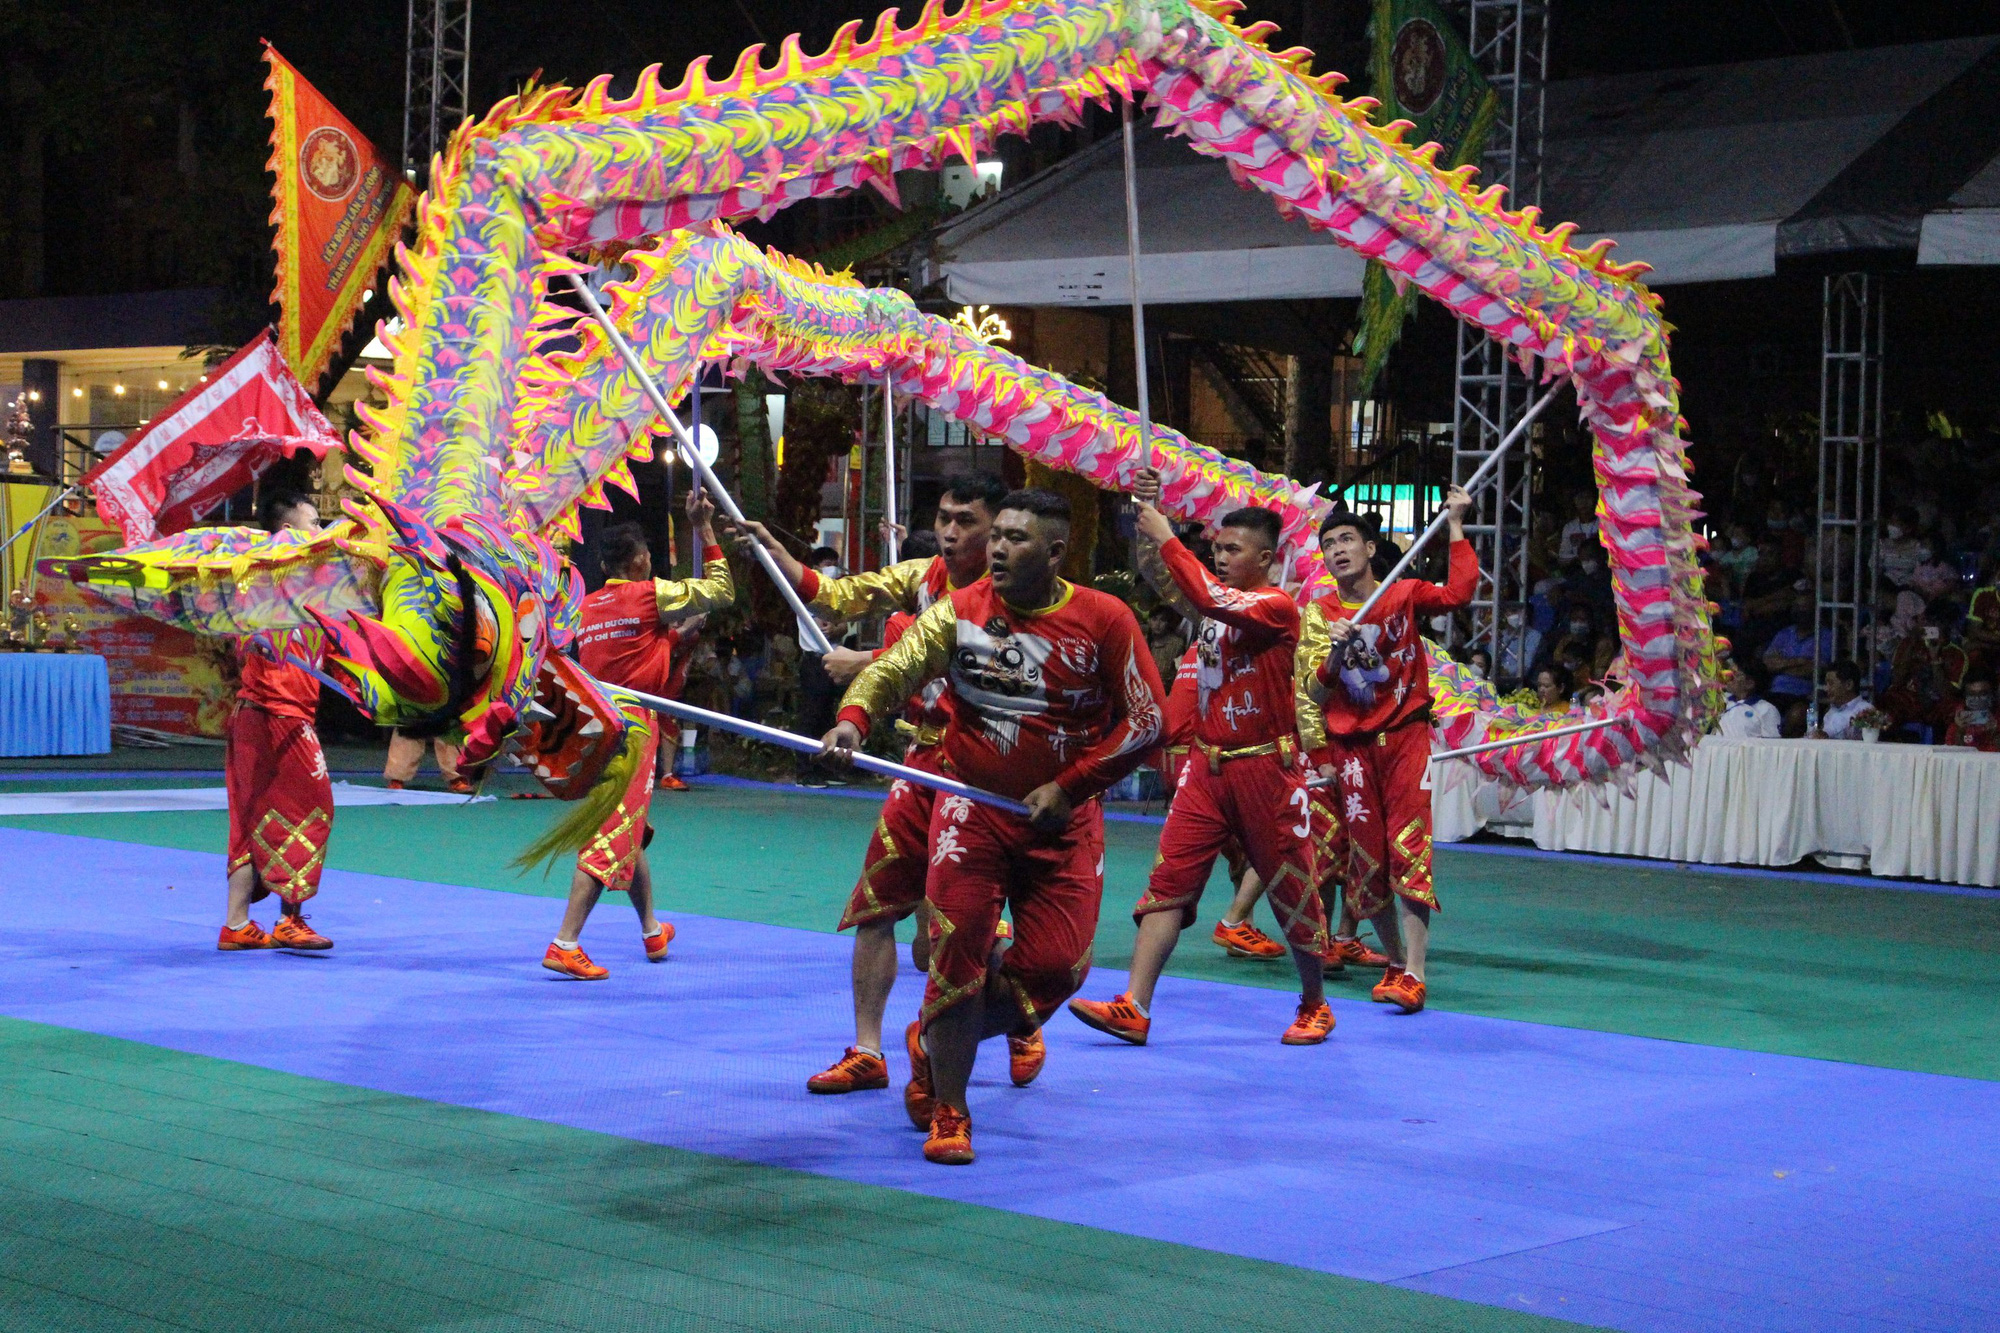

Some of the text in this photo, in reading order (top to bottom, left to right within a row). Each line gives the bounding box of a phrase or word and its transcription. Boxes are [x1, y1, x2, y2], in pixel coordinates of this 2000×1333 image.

[1222, 690, 1260, 731] Anh
[1290, 787, 1311, 839] 3
[1340, 756, 1371, 823] 精英
[931, 795, 976, 866] 精英
